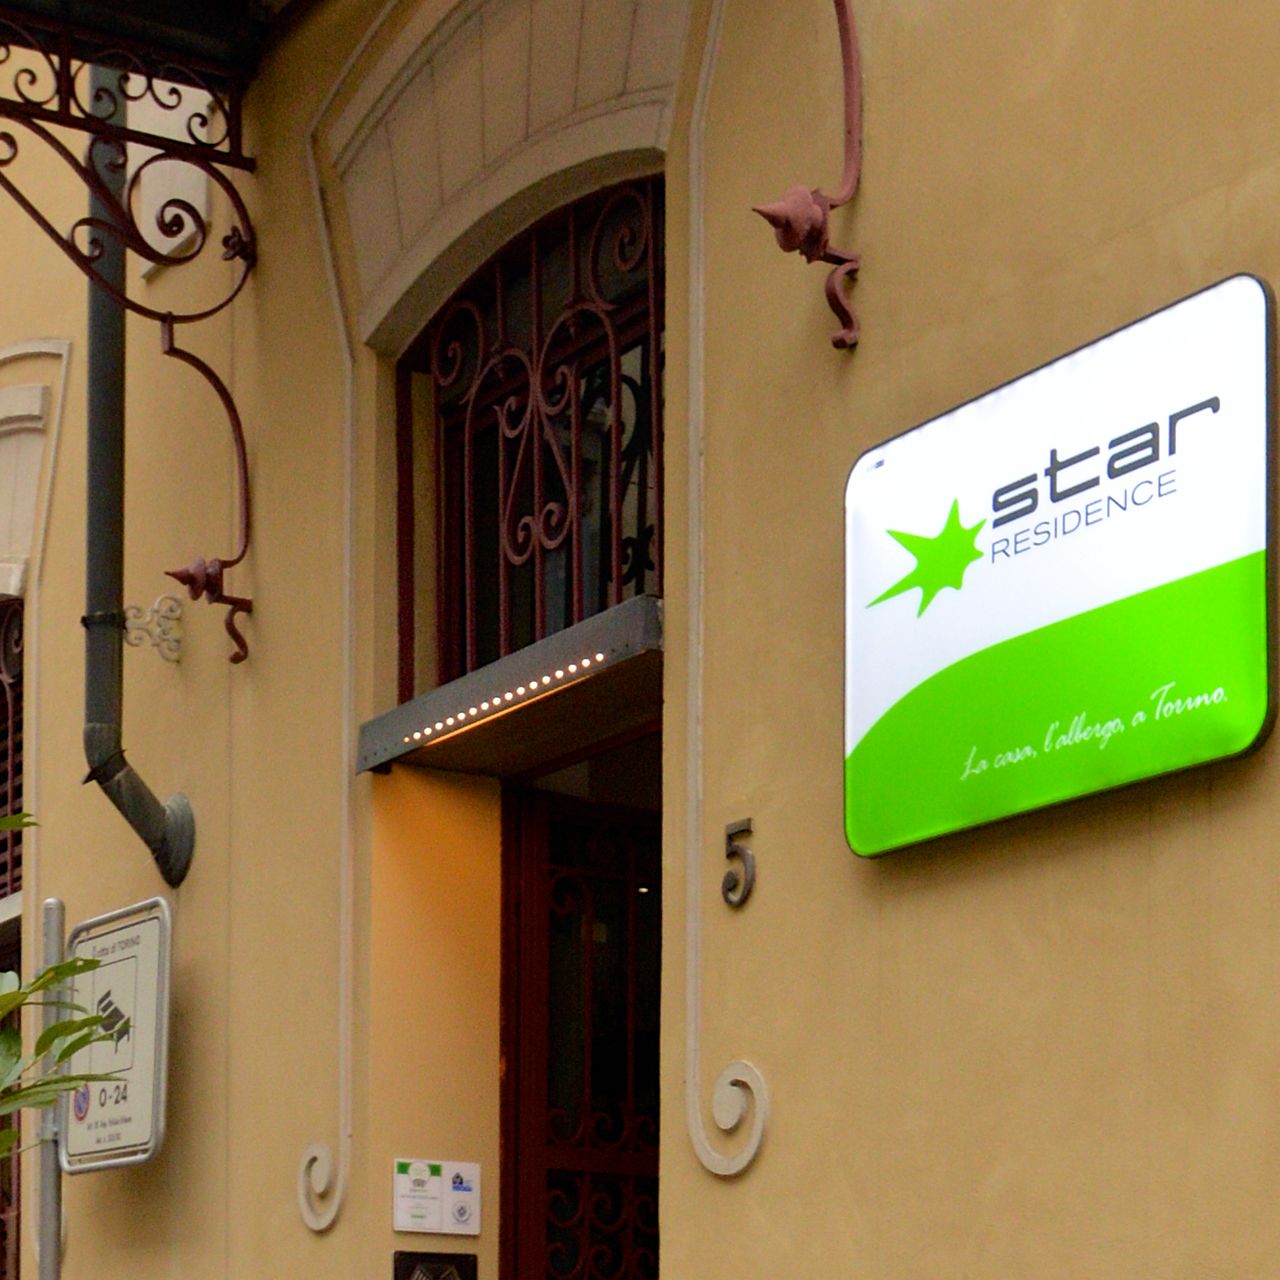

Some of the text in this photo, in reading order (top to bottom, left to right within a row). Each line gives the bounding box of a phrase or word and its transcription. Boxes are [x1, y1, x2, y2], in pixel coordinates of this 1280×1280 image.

[992, 395, 1221, 529] star
[991, 469, 1177, 564] RESIDENCE
[960, 746, 988, 780] La
[994, 745, 1037, 769] casa,
[1043, 711, 1125, 752] l'albergo,
[1131, 710, 1146, 727] a
[722, 817, 756, 908] 5
